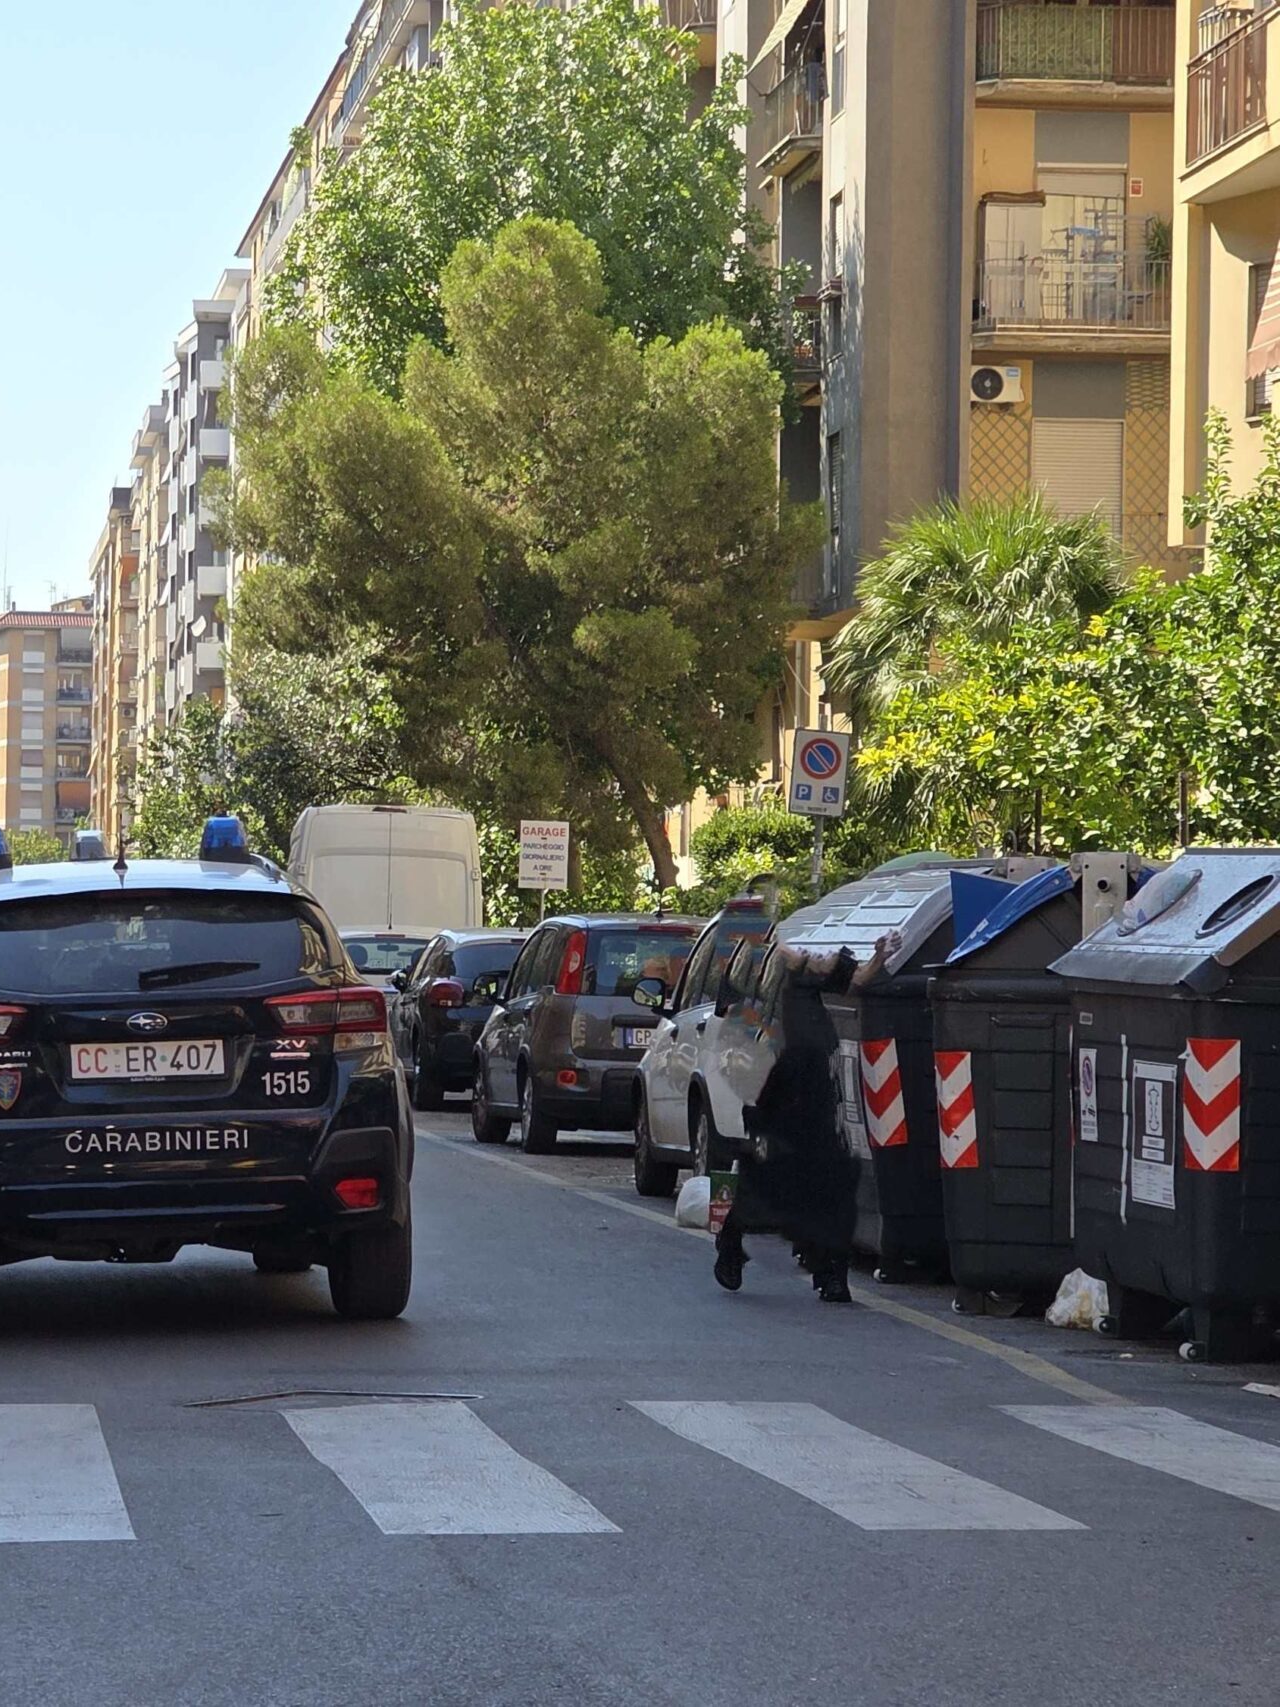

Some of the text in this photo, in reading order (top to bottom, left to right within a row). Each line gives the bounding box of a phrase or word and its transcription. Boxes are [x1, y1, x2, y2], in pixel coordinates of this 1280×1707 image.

[798, 786, 809, 798] P
[522, 826, 567, 837] GARAGE
[523, 842, 565, 851] PARCHEGGIO
[274, 1039, 307, 1050] XV
[77, 1043, 218, 1074] CC ER 407
[261, 1070, 311, 1096] 1515
[64, 1129, 249, 1153] CARABINIERI
